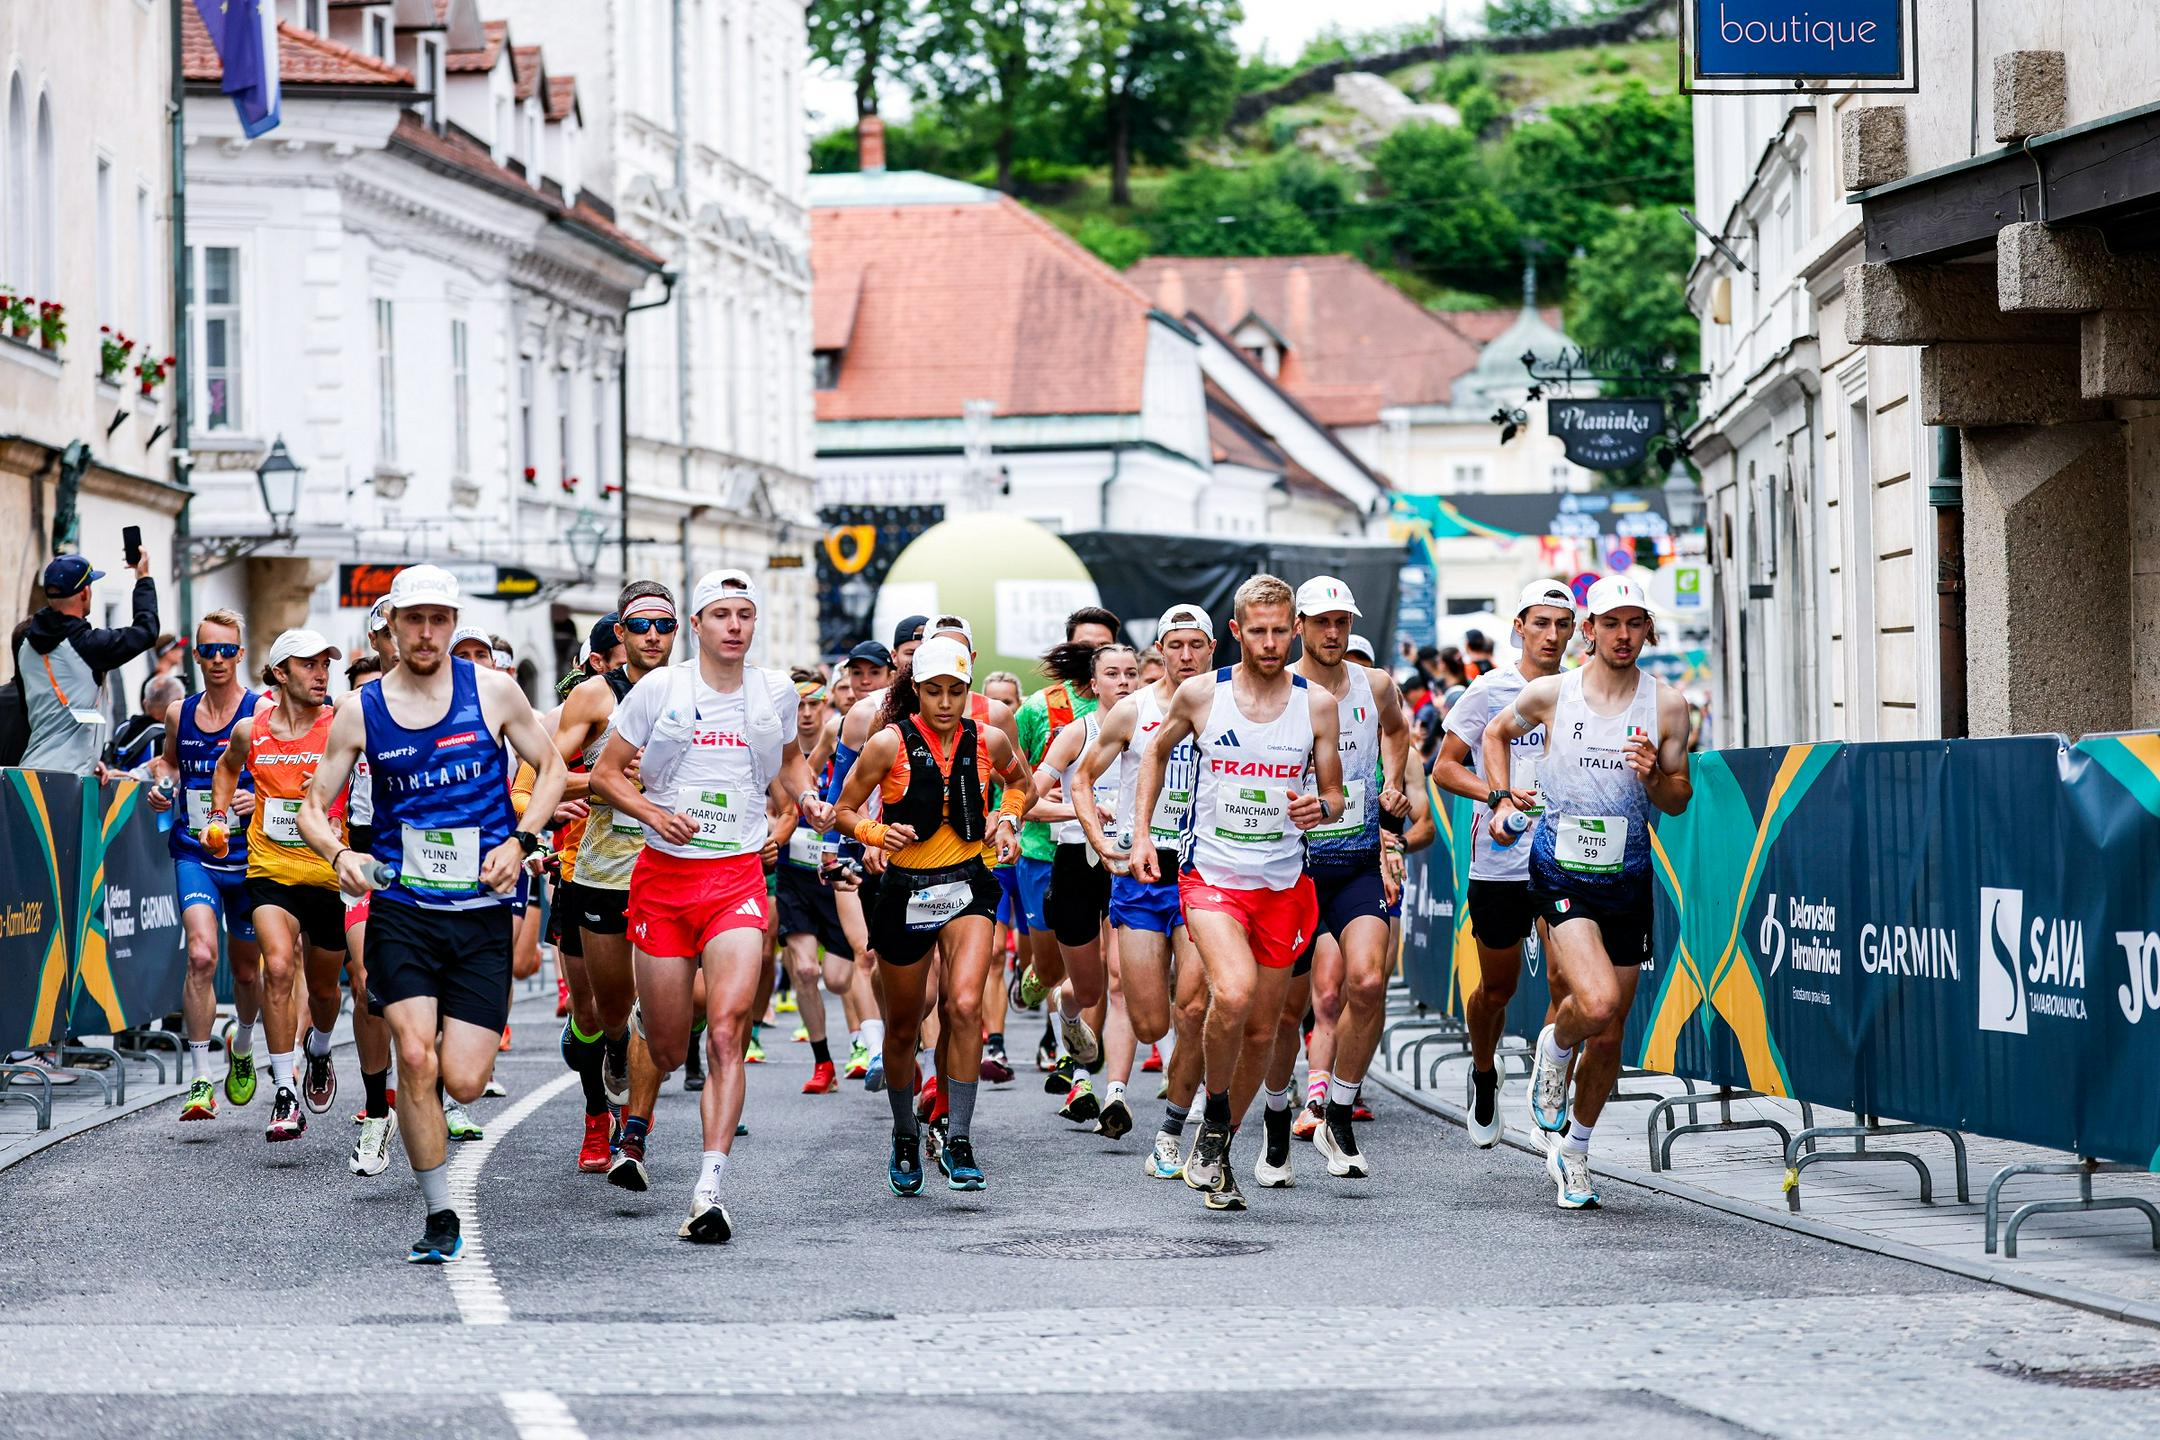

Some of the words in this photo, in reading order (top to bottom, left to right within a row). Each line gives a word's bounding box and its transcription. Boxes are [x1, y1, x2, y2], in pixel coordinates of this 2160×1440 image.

[1720, 2, 1877, 51] boutique
[1559, 406, 1650, 434] Planinka
[182, 739, 200, 747] CRAFT
[438, 734, 476, 748] motonet
[255, 751, 324, 765] ESPAÑA
[378, 748, 408, 760] CRAFT
[1210, 758, 1303, 778] FRANCE
[1579, 757, 1624, 770] ITALIA
[387, 761, 481, 791] FINLAND
[686, 808, 737, 822] CHARVOLIN
[1224, 804, 1280, 816] TRANCHAND
[702, 822, 717, 834] 32
[1244, 818, 1258, 828] 33
[1578, 835, 1607, 847] PATTIS
[422, 849, 458, 861] YLINEN
[1584, 848, 1598, 858] 59
[432, 863, 447, 874] 28
[140, 894, 178, 932] GARMIN
[1790, 896, 1836, 932] Delavska
[1792, 936, 1841, 975] Hranilnica
[1860, 922, 1959, 981] GARMIN
[2028, 916, 2085, 988] SAVA
[2029, 992, 2088, 1020] ZAVAROVALNICA
